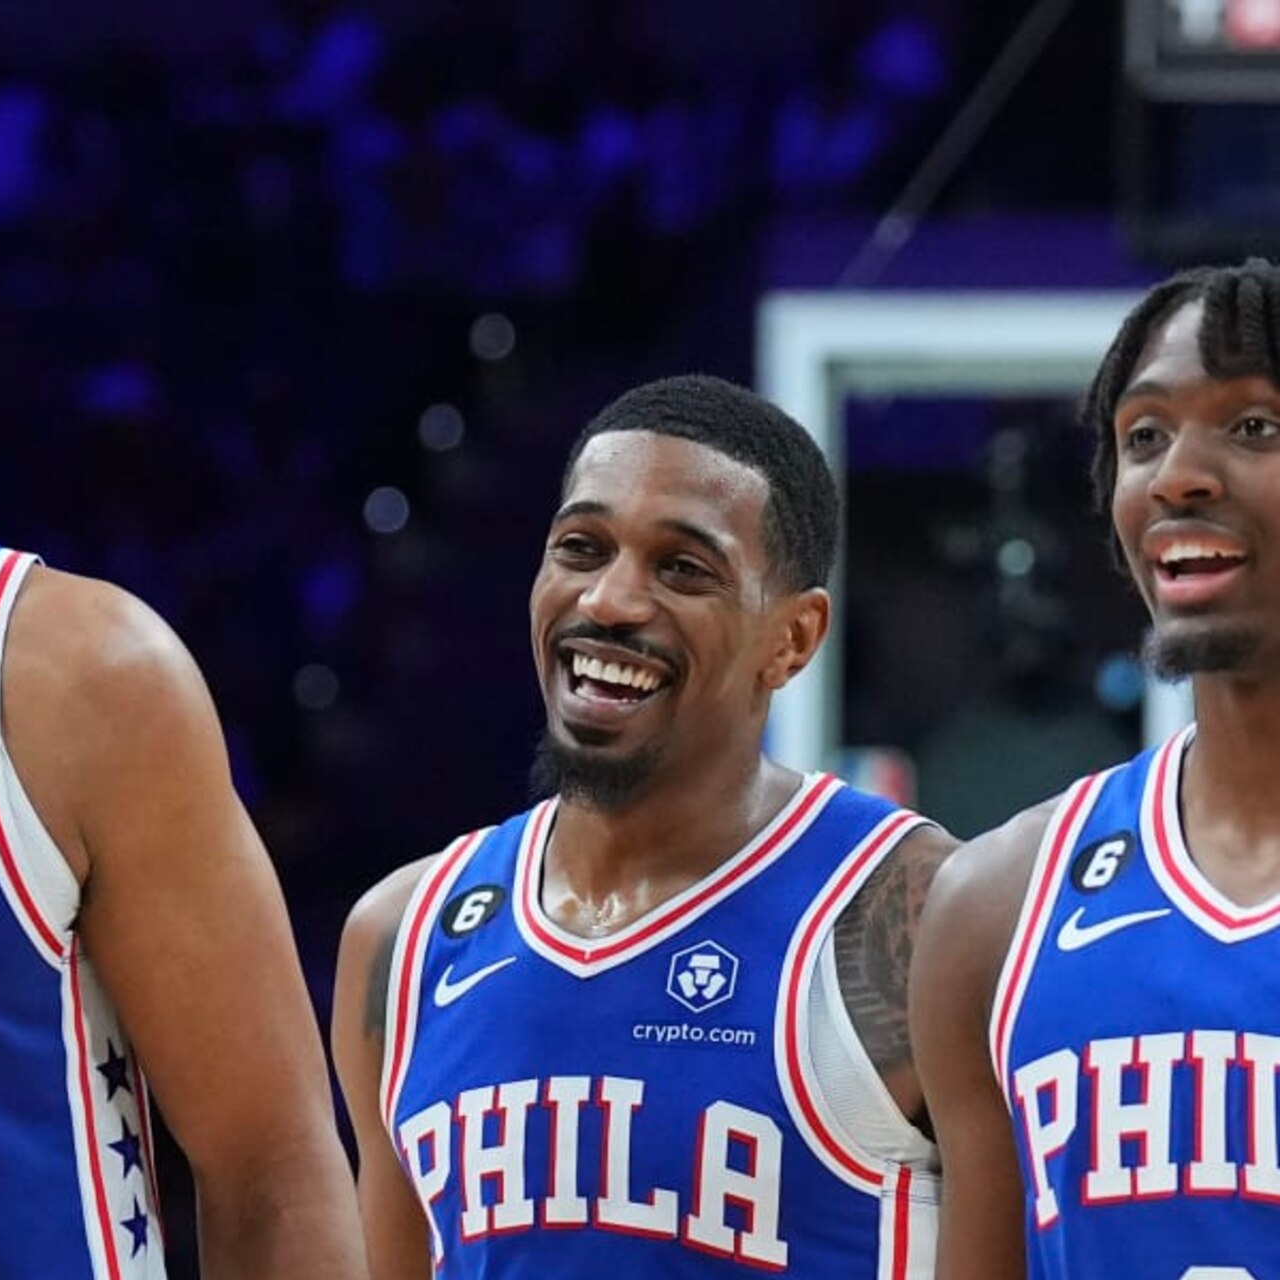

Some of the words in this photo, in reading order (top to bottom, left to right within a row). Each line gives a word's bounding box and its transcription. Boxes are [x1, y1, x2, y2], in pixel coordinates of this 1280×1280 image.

[1082, 839, 1126, 888] 6
[452, 891, 494, 931] 6
[632, 1022, 755, 1046] crypto.com
[402, 1075, 789, 1272] PHILA
